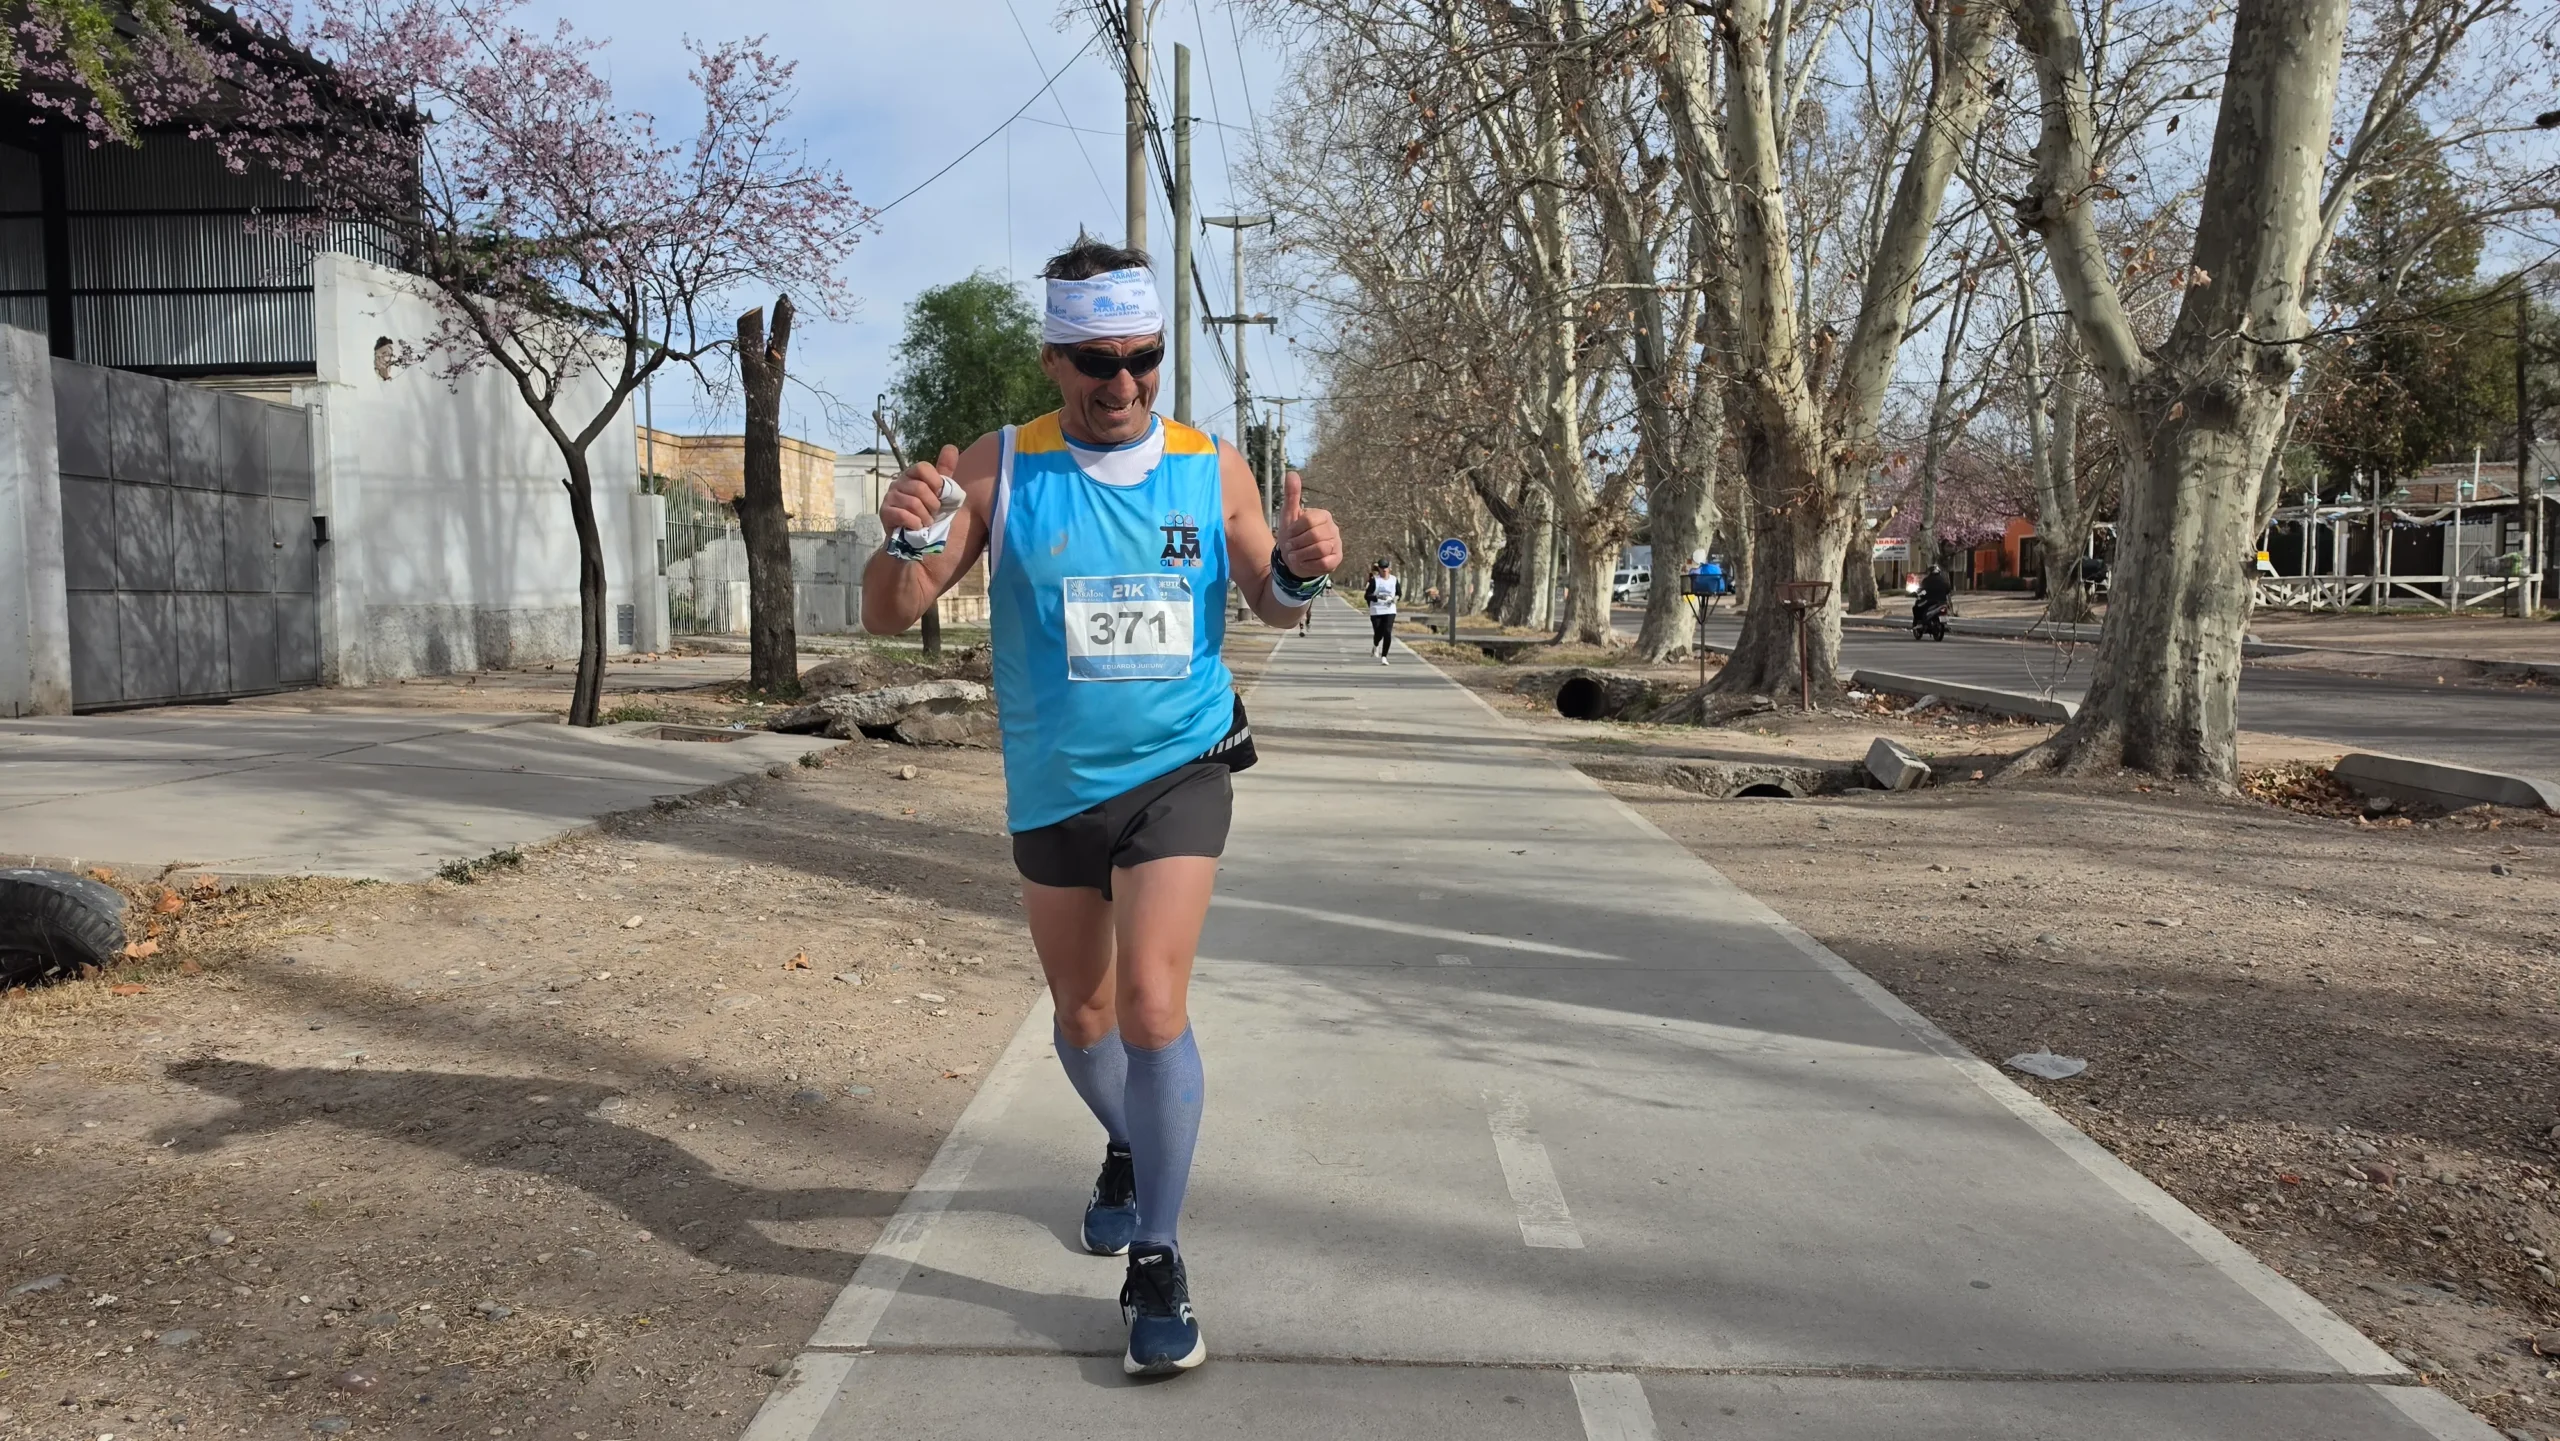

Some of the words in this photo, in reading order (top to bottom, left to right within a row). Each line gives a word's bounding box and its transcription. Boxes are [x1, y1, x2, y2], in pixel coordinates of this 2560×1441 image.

[1093, 302, 1140, 313] MARATON
[1071, 589, 1104, 598] MARATON
[1112, 583, 1146, 599] 21K
[1090, 611, 1167, 645] 371
